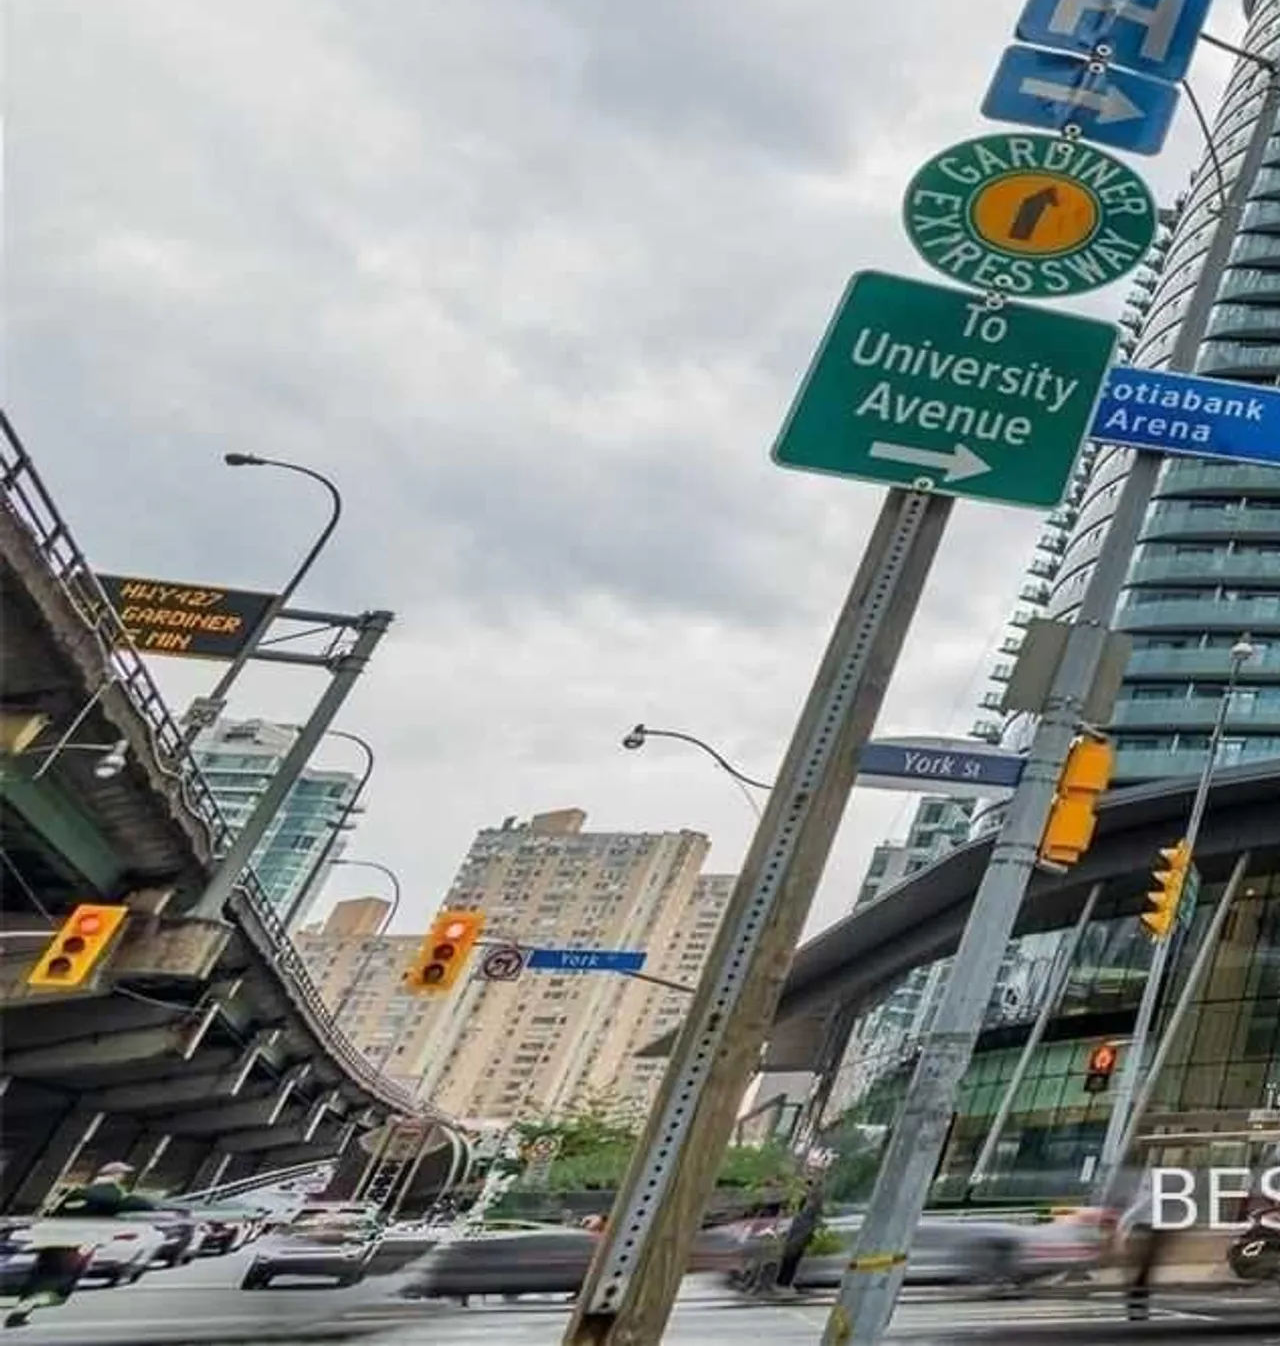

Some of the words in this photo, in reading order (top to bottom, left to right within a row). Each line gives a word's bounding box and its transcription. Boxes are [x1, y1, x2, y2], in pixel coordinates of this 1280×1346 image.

[938, 138, 1148, 218] GARDINER
[912, 189, 1142, 294] EXPRESSWAY
[962, 301, 1009, 344] To
[852, 326, 1079, 413] University
[856, 380, 1032, 446] Avenue
[1103, 407, 1214, 444] Arena
[121, 605, 244, 635] GARDINER
[145, 630, 194, 651] MIN
[903, 751, 956, 776] York
[962, 759, 983, 779] St
[561, 952, 600, 968] York
